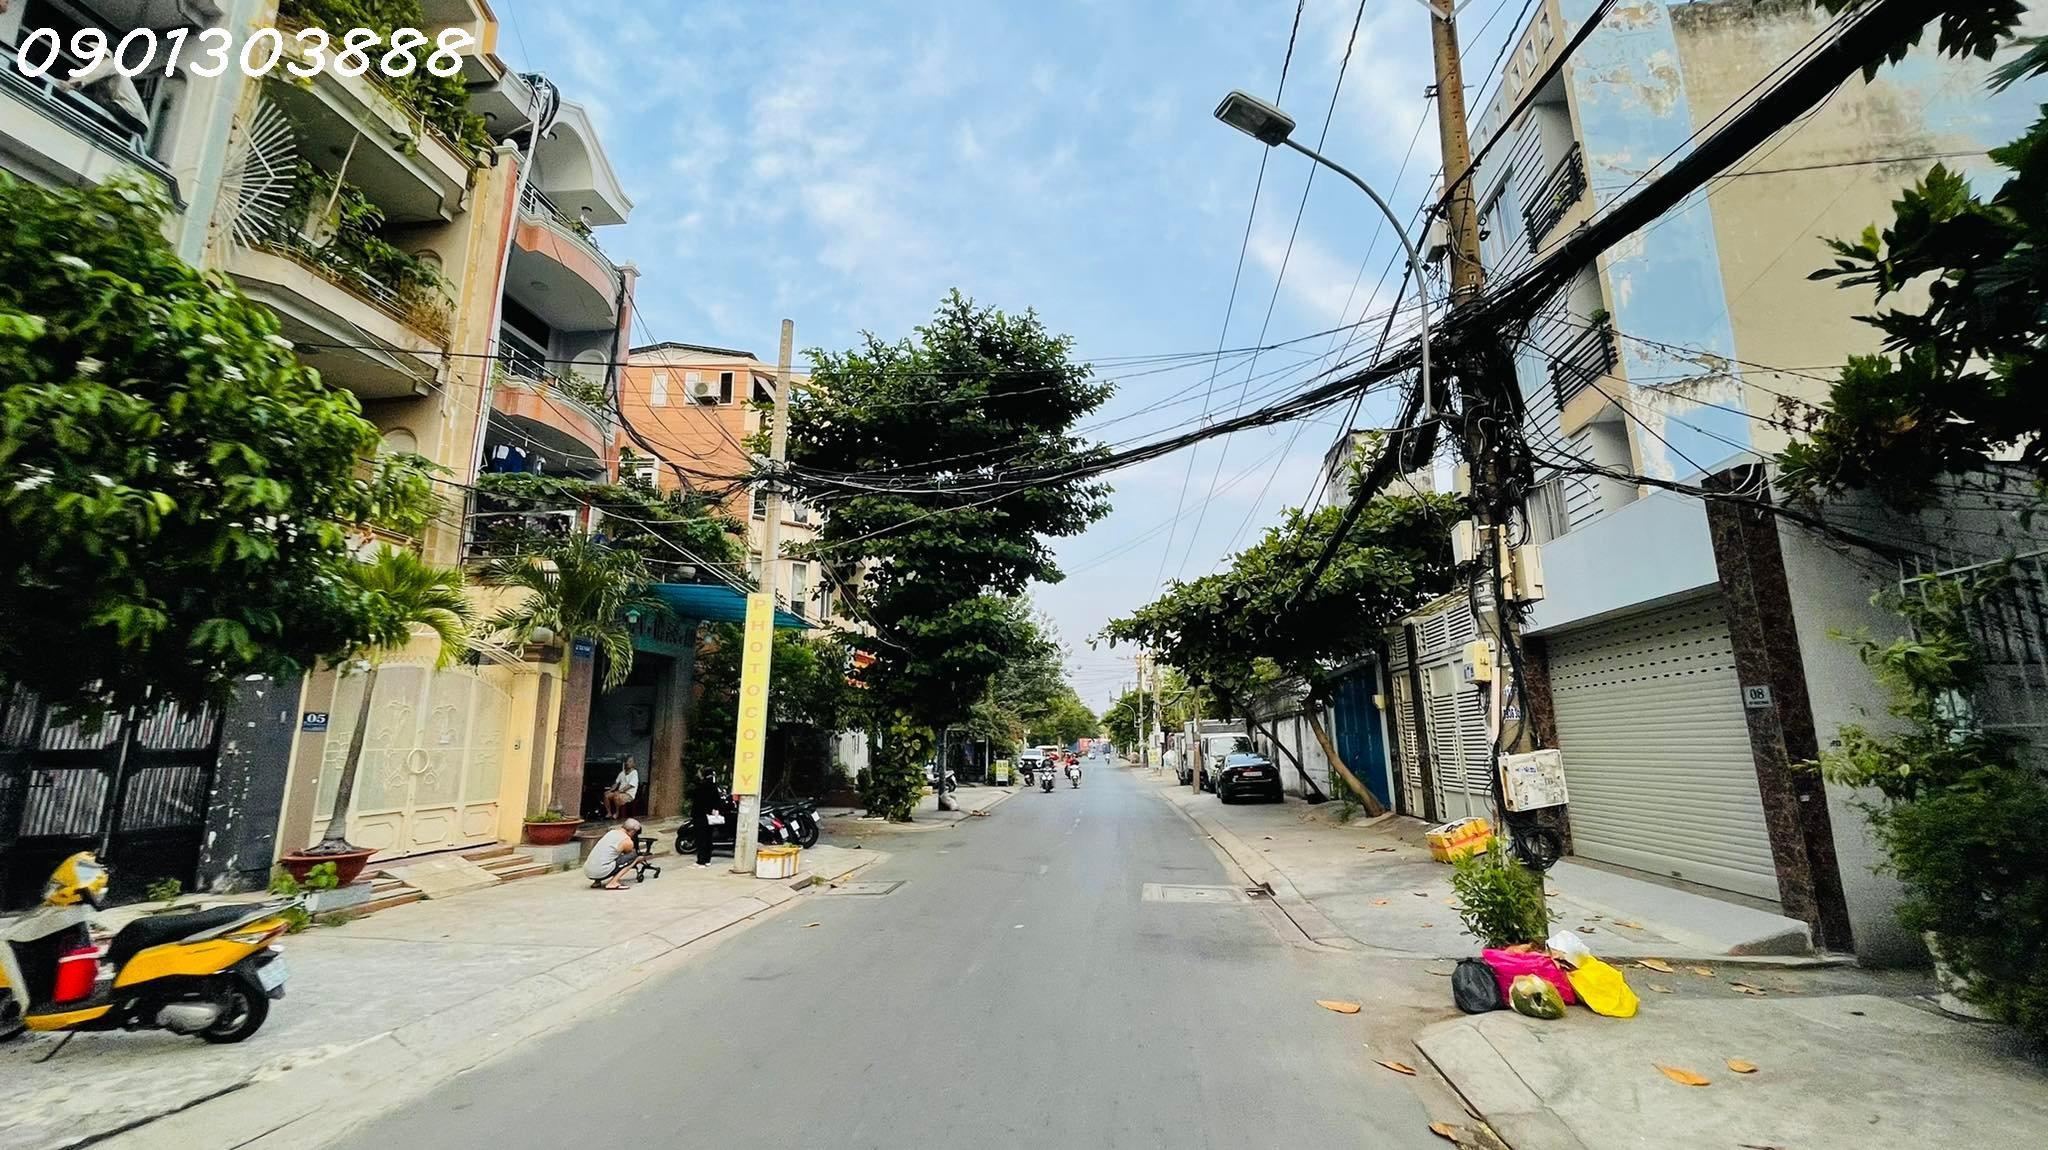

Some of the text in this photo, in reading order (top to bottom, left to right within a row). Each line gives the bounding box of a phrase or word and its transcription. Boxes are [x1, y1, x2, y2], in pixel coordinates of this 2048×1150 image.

[740, 599, 767, 786] PHOTOCOPY
[1750, 688, 1764, 700] 08
[307, 713, 326, 723] 05
